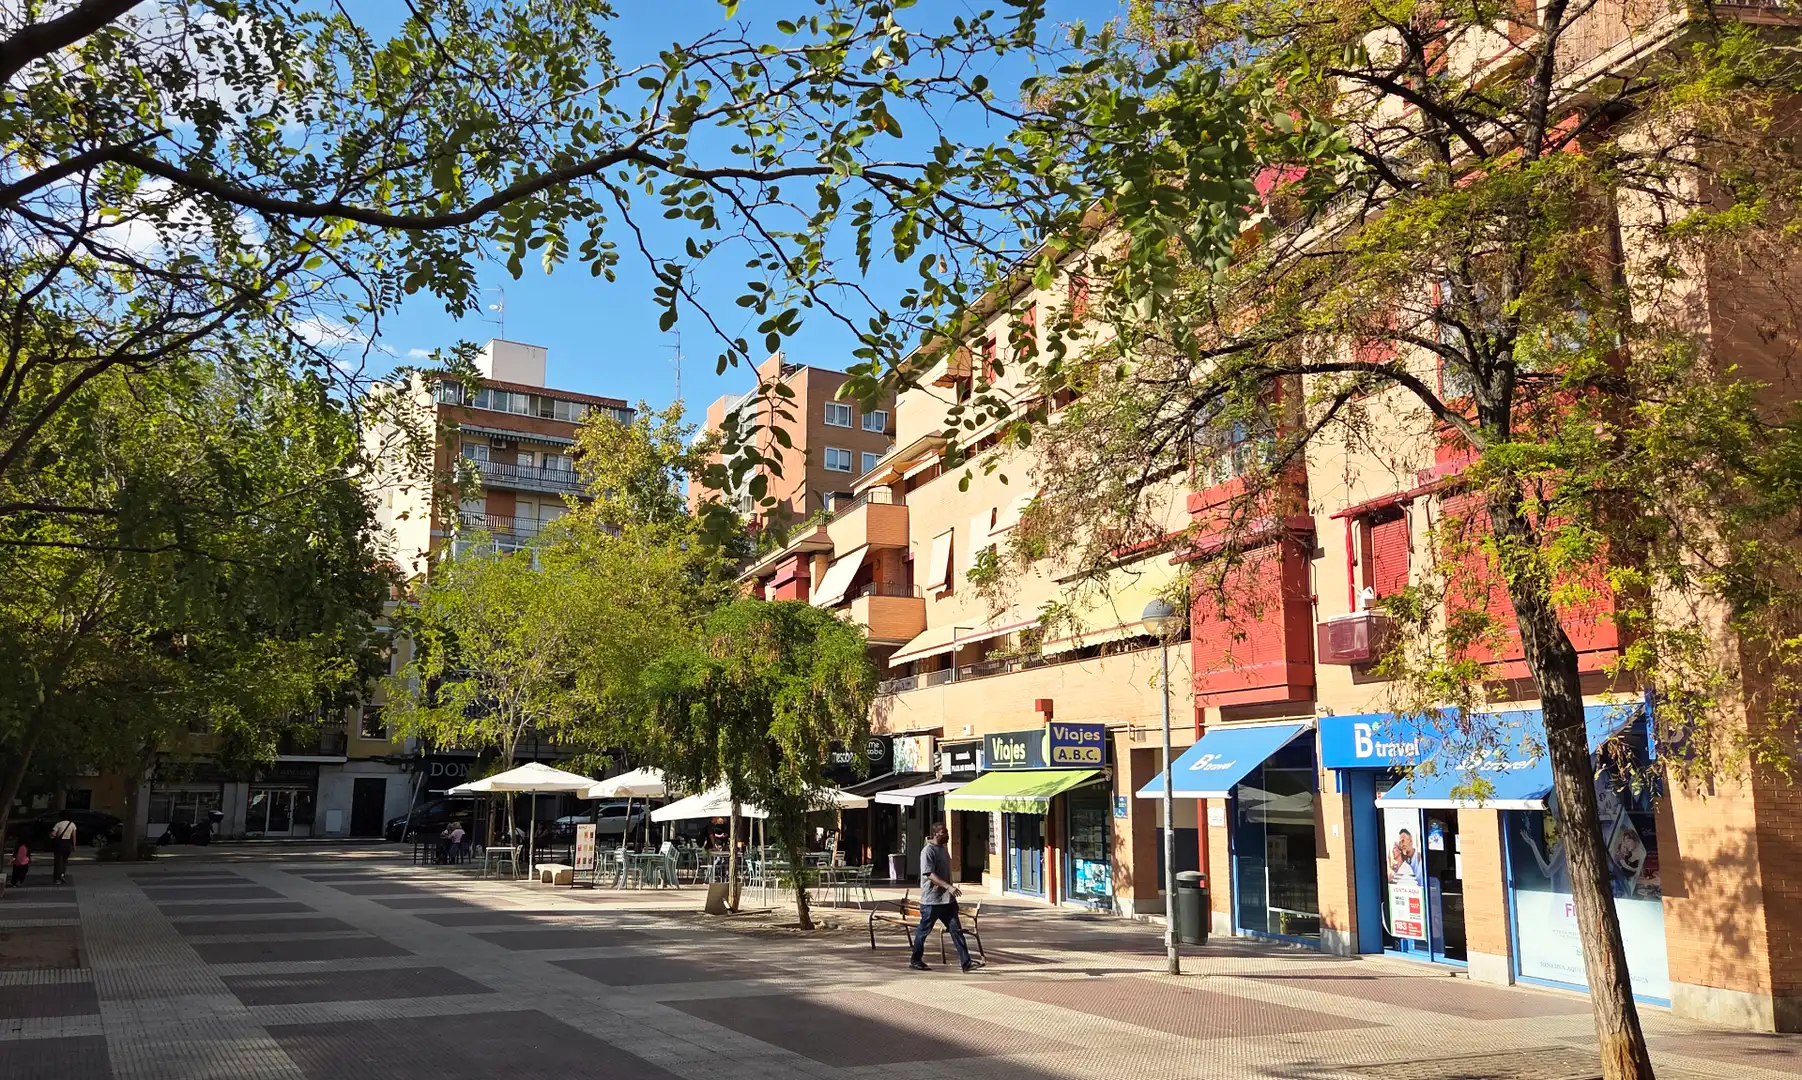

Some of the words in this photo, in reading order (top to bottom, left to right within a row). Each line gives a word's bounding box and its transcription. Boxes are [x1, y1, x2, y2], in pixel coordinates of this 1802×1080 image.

[1053, 726, 1100, 745] Viajes
[1353, 723, 1374, 758] B
[1375, 737, 1420, 758] travel
[991, 737, 1026, 767] Viajes
[1058, 748, 1098, 761] A.B.C.
[1188, 753, 1216, 771] B
